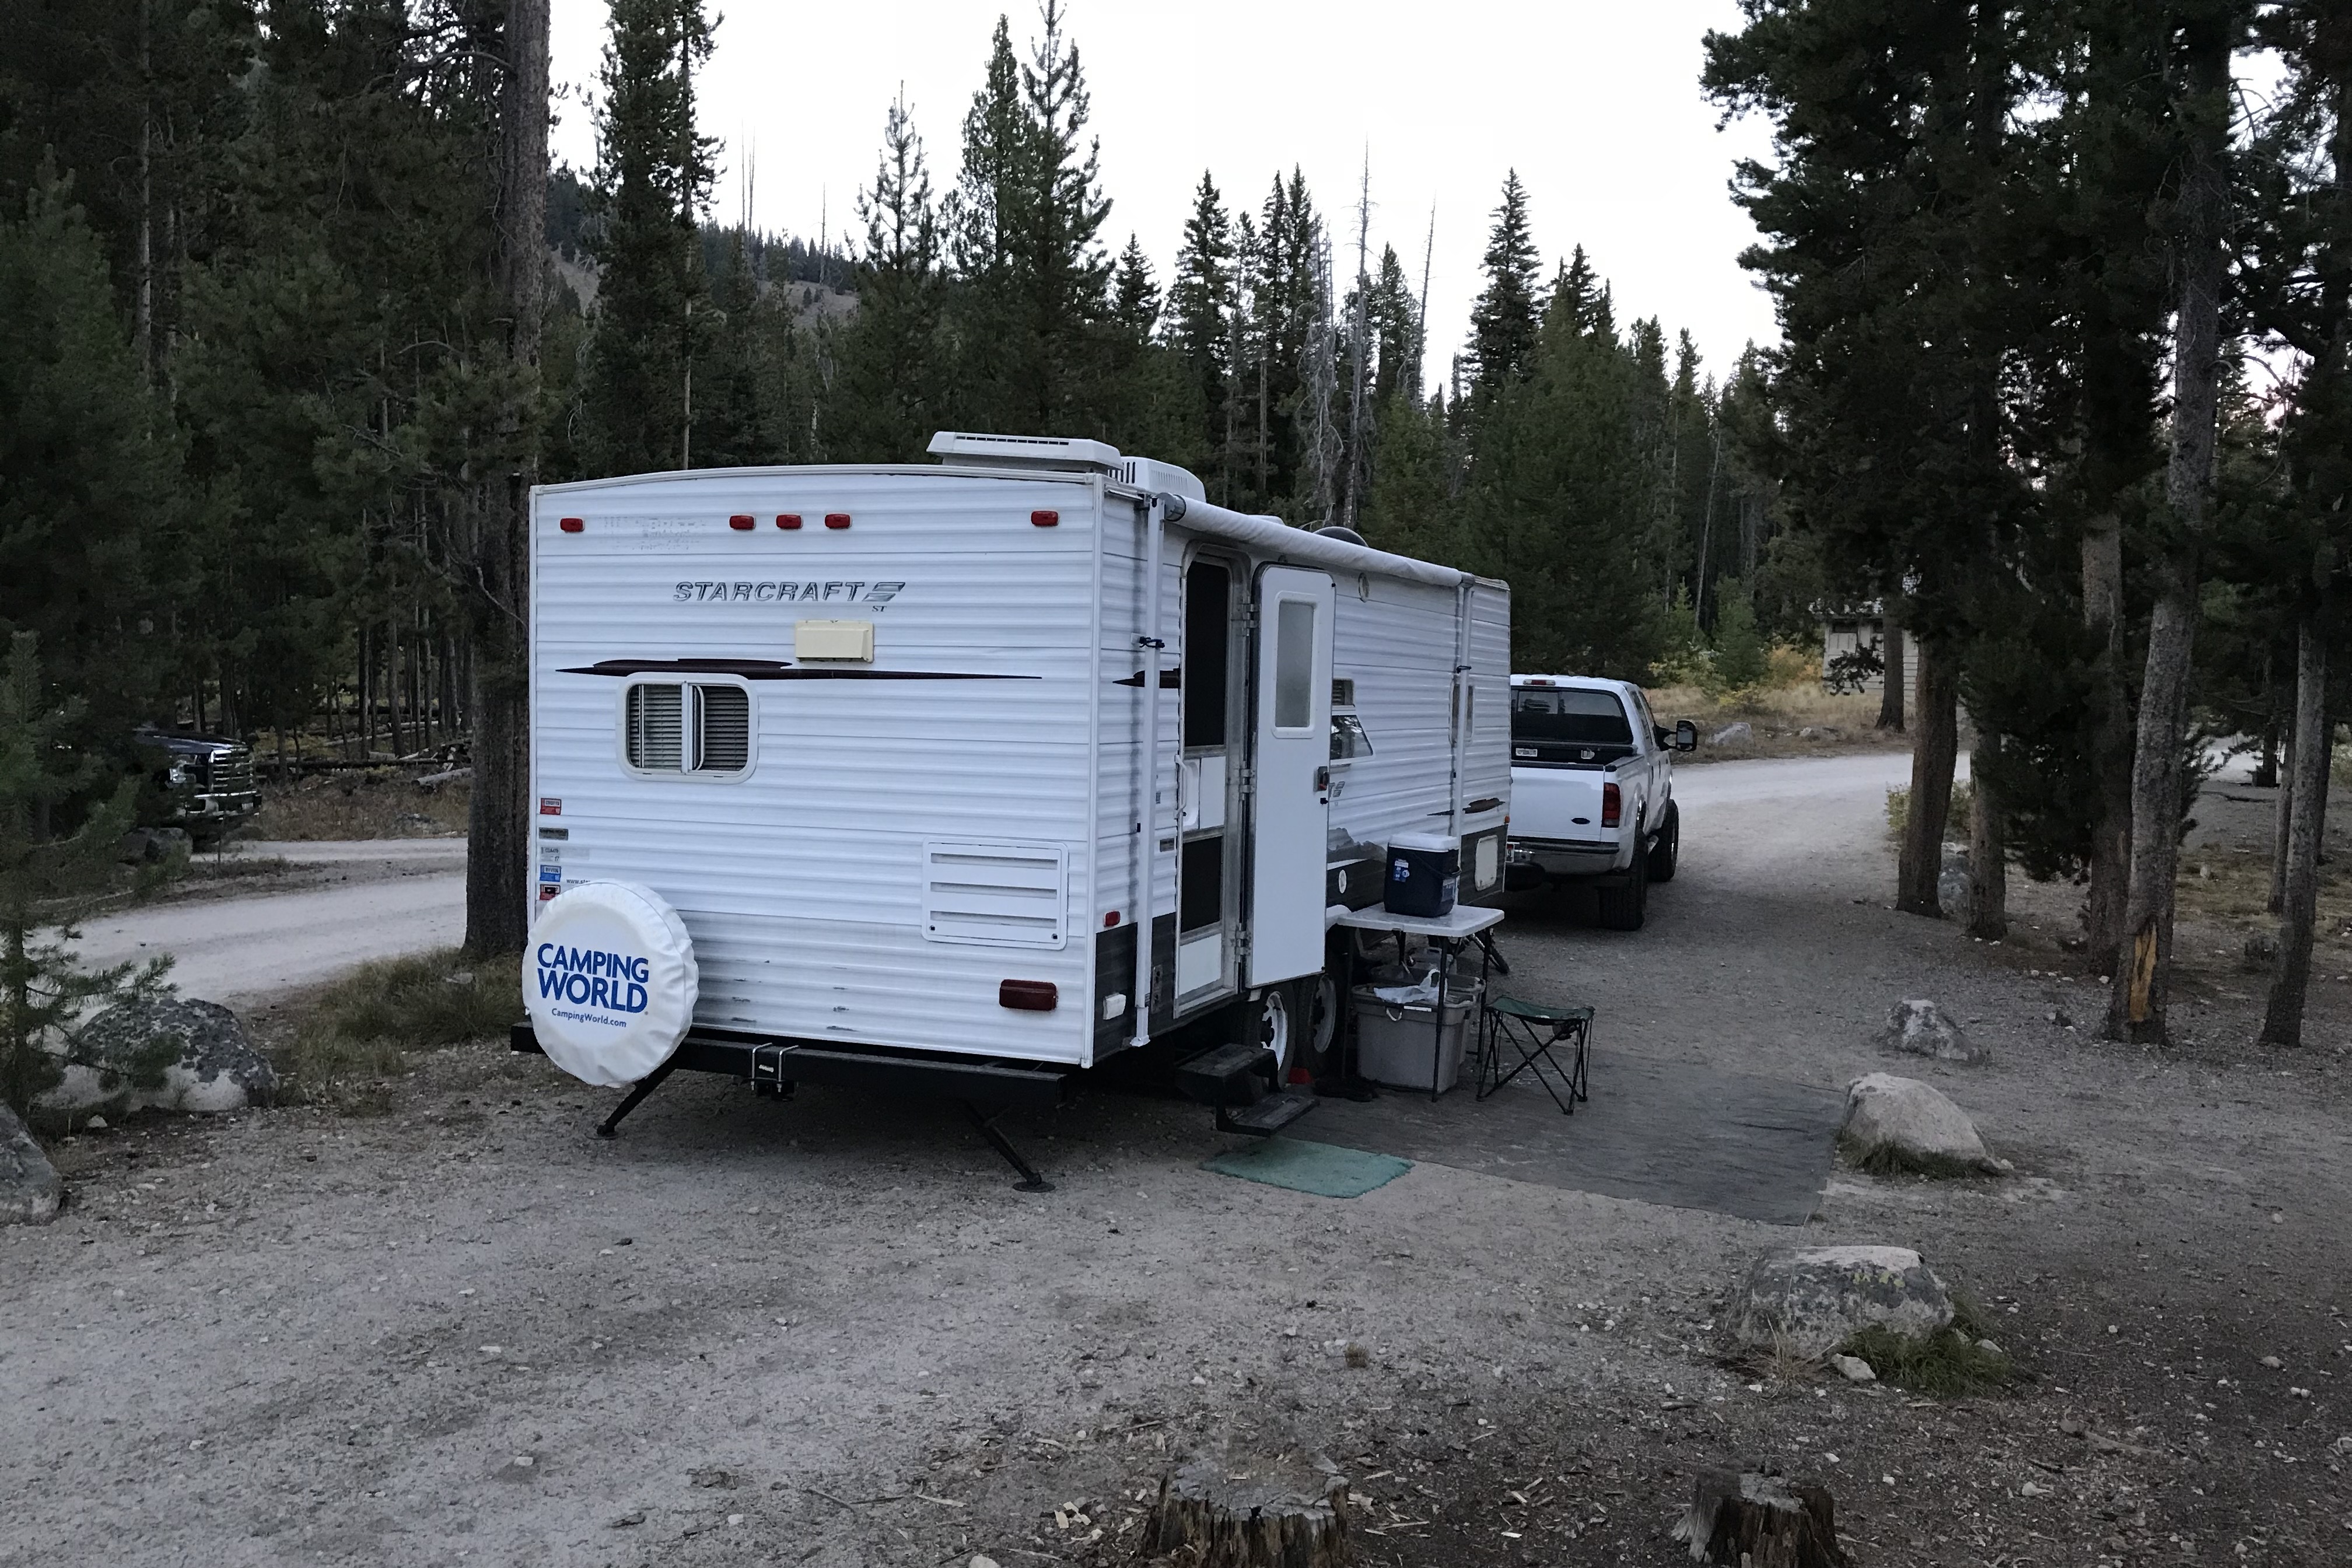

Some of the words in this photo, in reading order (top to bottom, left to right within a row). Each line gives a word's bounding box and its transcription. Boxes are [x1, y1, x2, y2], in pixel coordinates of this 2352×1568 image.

[673, 582, 865, 602] STARCRAFT
[537, 943, 649, 984] CAMPING
[537, 968, 648, 1014] WORLD
[551, 1007, 627, 1028] CampingWorld.com
